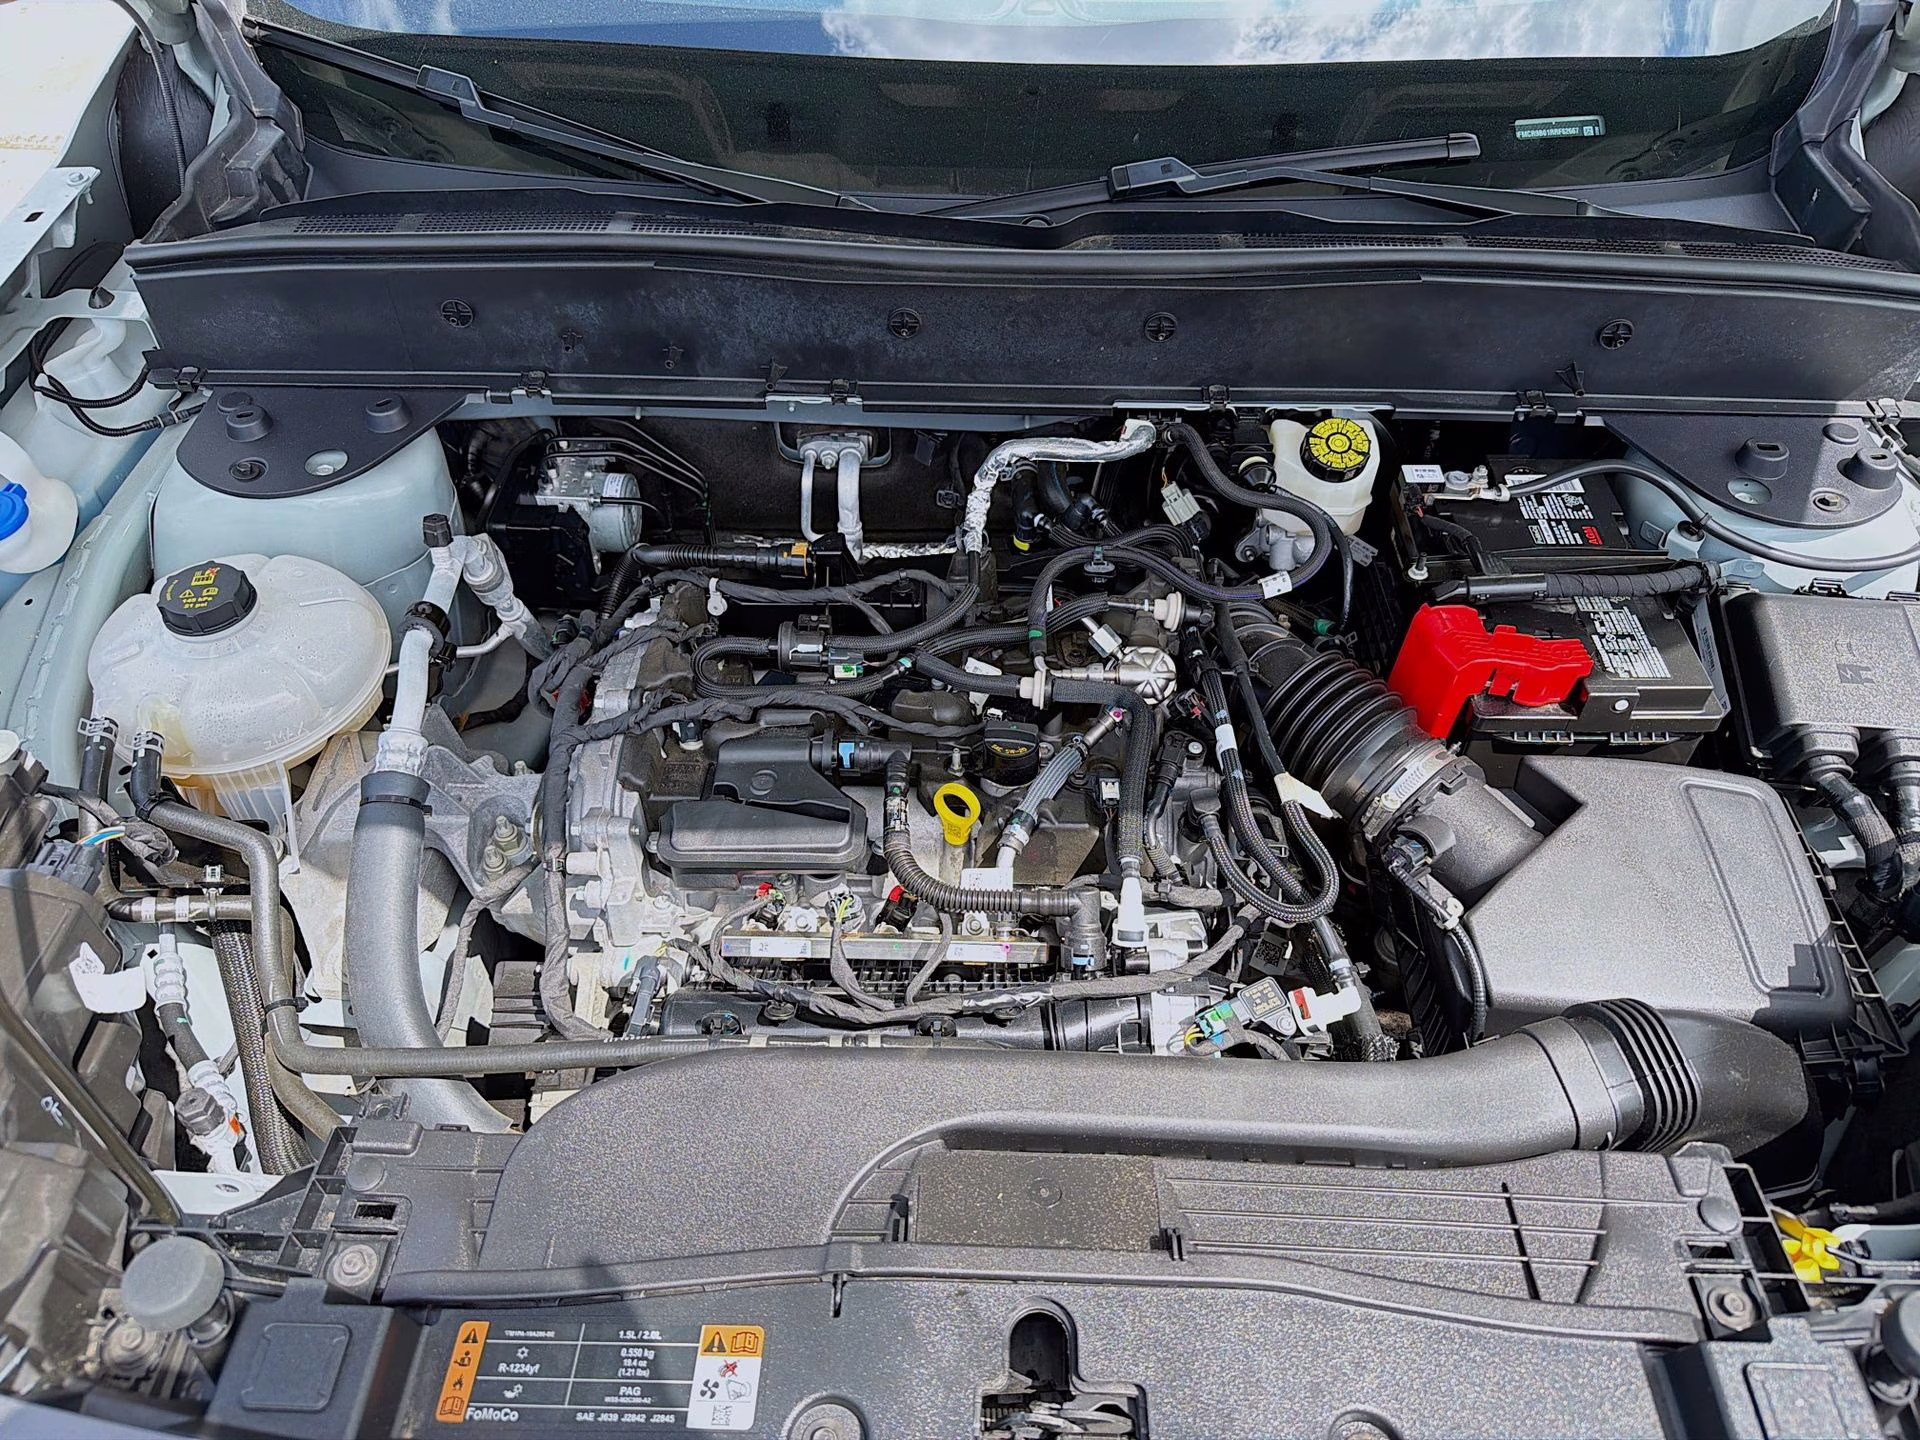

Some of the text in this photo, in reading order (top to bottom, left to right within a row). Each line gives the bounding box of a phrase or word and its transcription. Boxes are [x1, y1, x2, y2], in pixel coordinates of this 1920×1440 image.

[618, 1330, 637, 1340] 1.5L
[642, 1330, 662, 1340] 2.0L
[620, 1347, 655, 1360] 0.550 kg
[498, 1363, 540, 1374] R-1234yf
[619, 1386, 641, 1396] PAG
[465, 1407, 519, 1422] FoMoCo
[576, 1412, 595, 1421] SAE
[597, 1412, 619, 1422] J639
[621, 1413, 647, 1423] J2842
